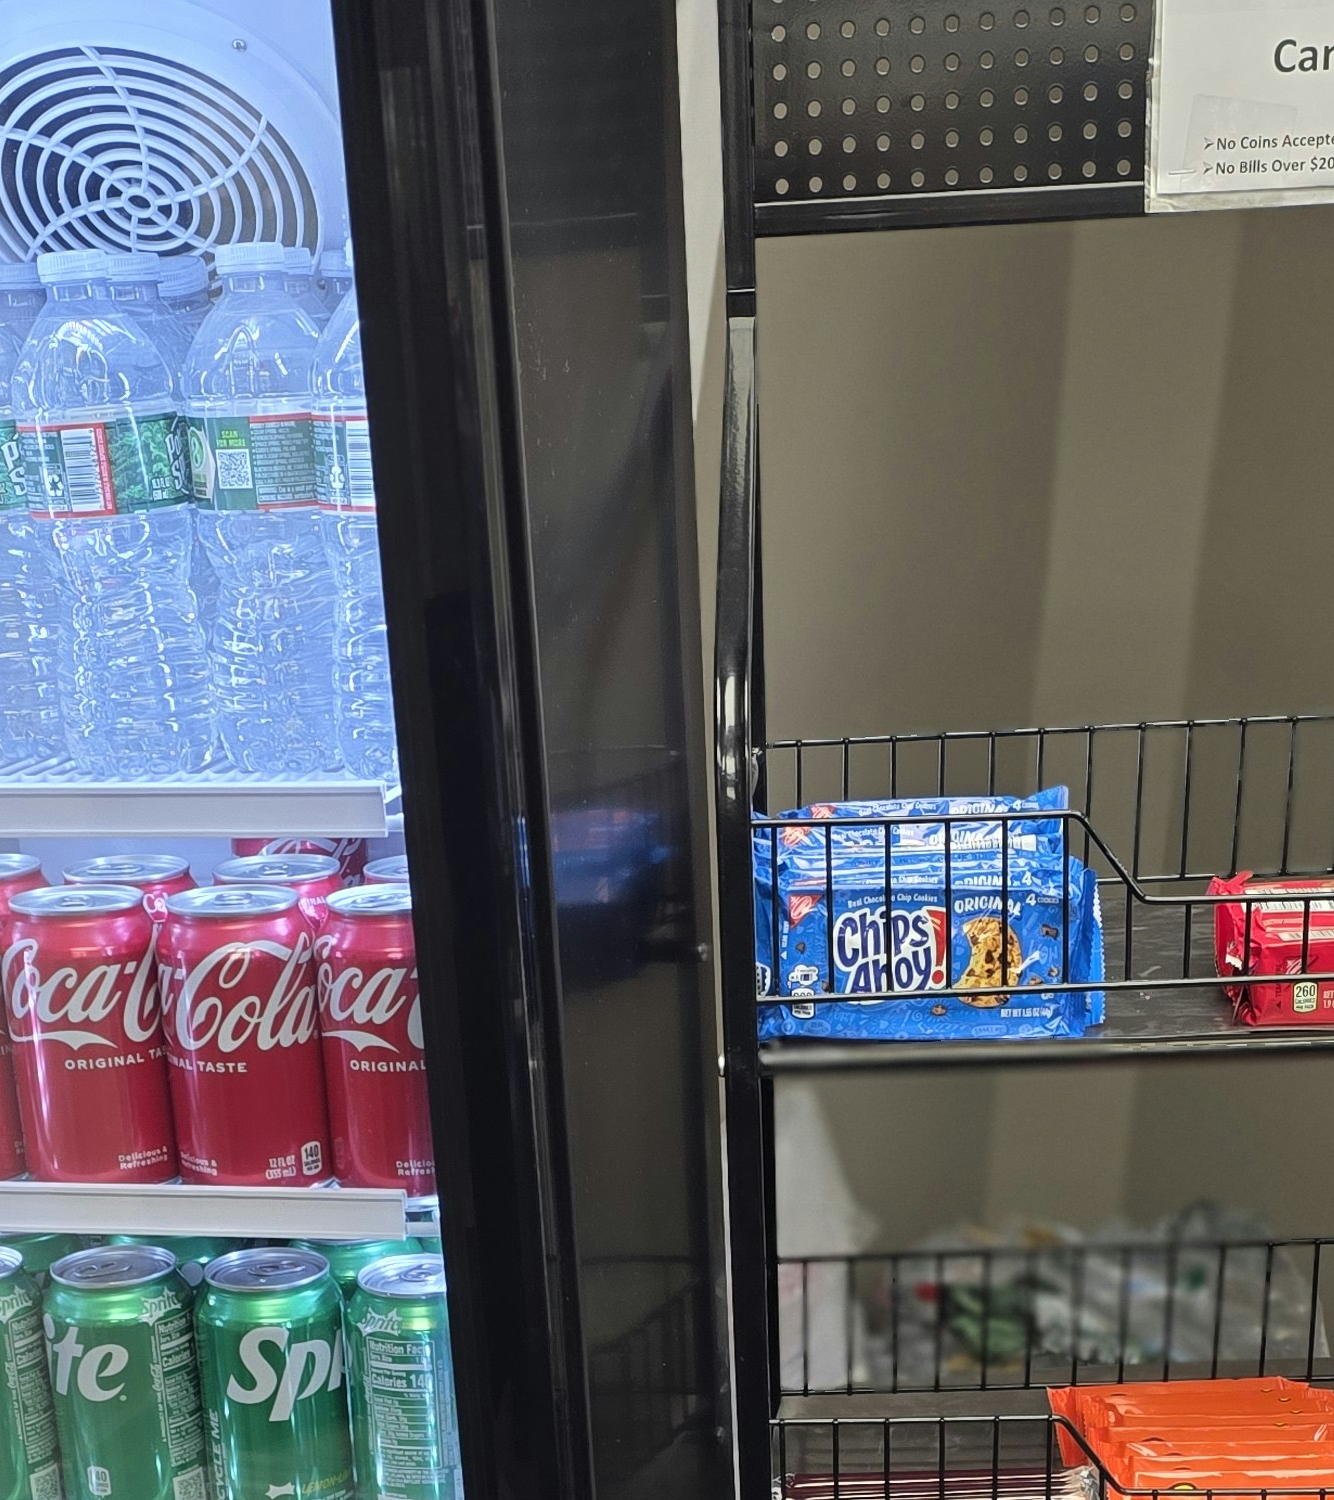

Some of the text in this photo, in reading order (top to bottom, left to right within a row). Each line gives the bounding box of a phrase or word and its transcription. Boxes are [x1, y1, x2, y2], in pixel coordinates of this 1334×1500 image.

[1217, 137, 1236, 150] No
[1240, 136, 1278, 149] Coins
[1216, 162, 1235, 175] No
[1240, 160, 1267, 174] Bills
[1272, 160, 1306, 173] Over
[837, 909, 929, 969] Chips
[1296, 984, 1316, 998] 260
[65, 1053, 145, 1071] ORIGINAL
[197, 1061, 247, 1073] TASTE
[303, 1145, 319, 1160] 140
[372, 1374, 407, 1388] Calories
